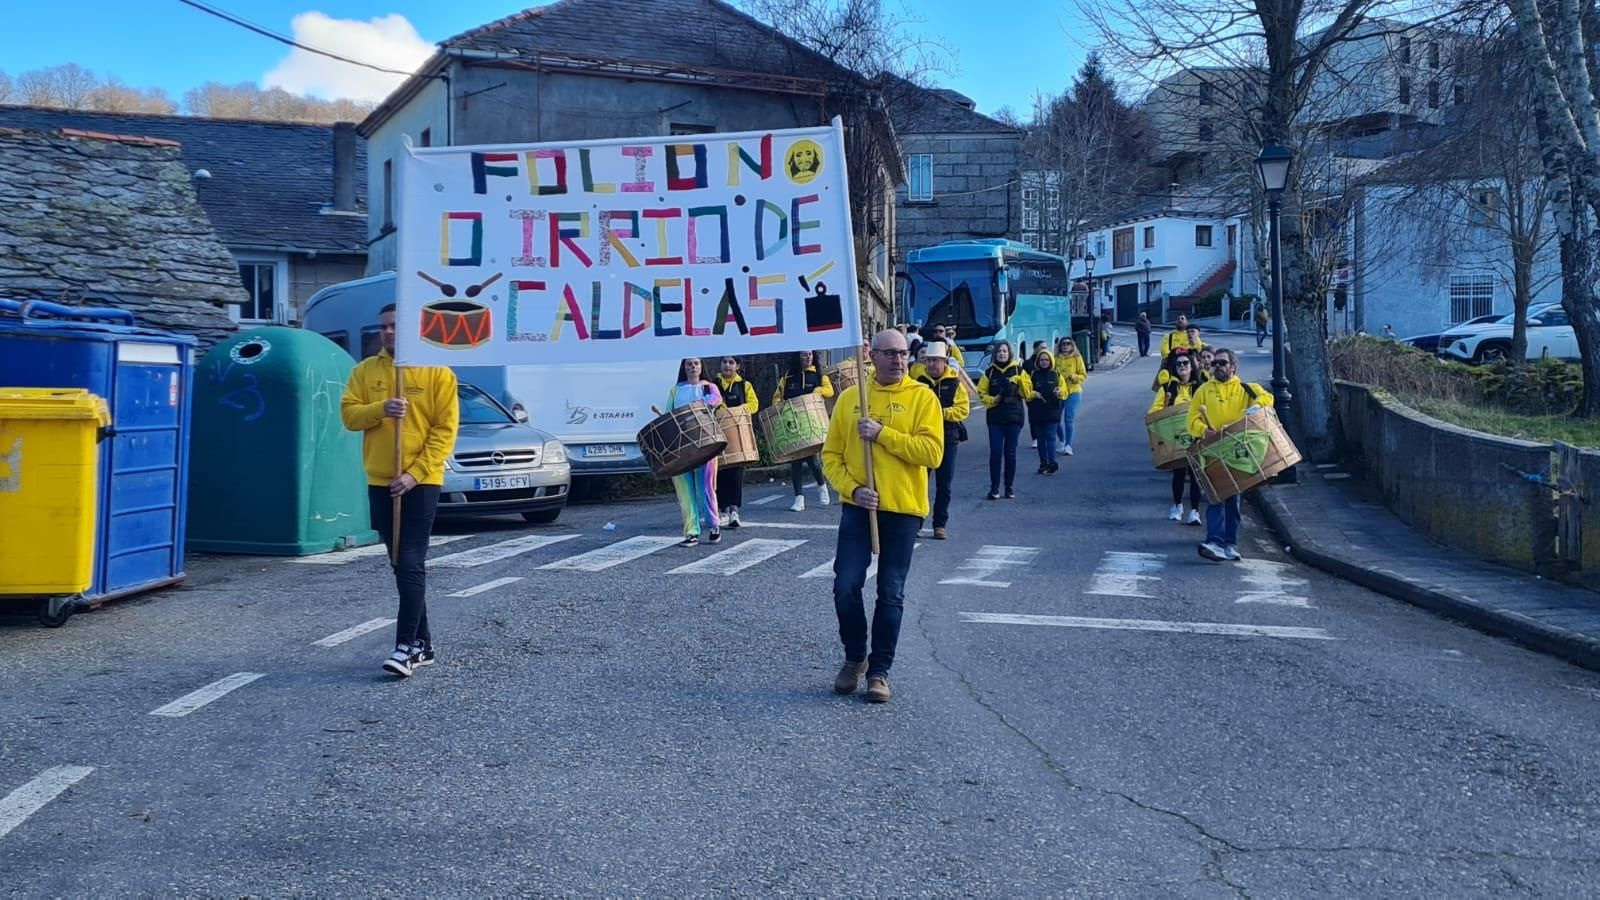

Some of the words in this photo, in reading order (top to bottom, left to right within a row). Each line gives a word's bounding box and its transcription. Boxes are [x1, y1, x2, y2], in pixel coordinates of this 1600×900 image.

[471, 133, 772, 195] FOLION
[440, 211, 483, 267] O
[509, 205, 729, 268] IRRIO
[755, 194, 822, 261] DE
[506, 273, 788, 342] CALDELAS
[588, 445, 608, 455] 4285
[482, 477, 507, 489] 5195
[510, 475, 528, 487] CFV
